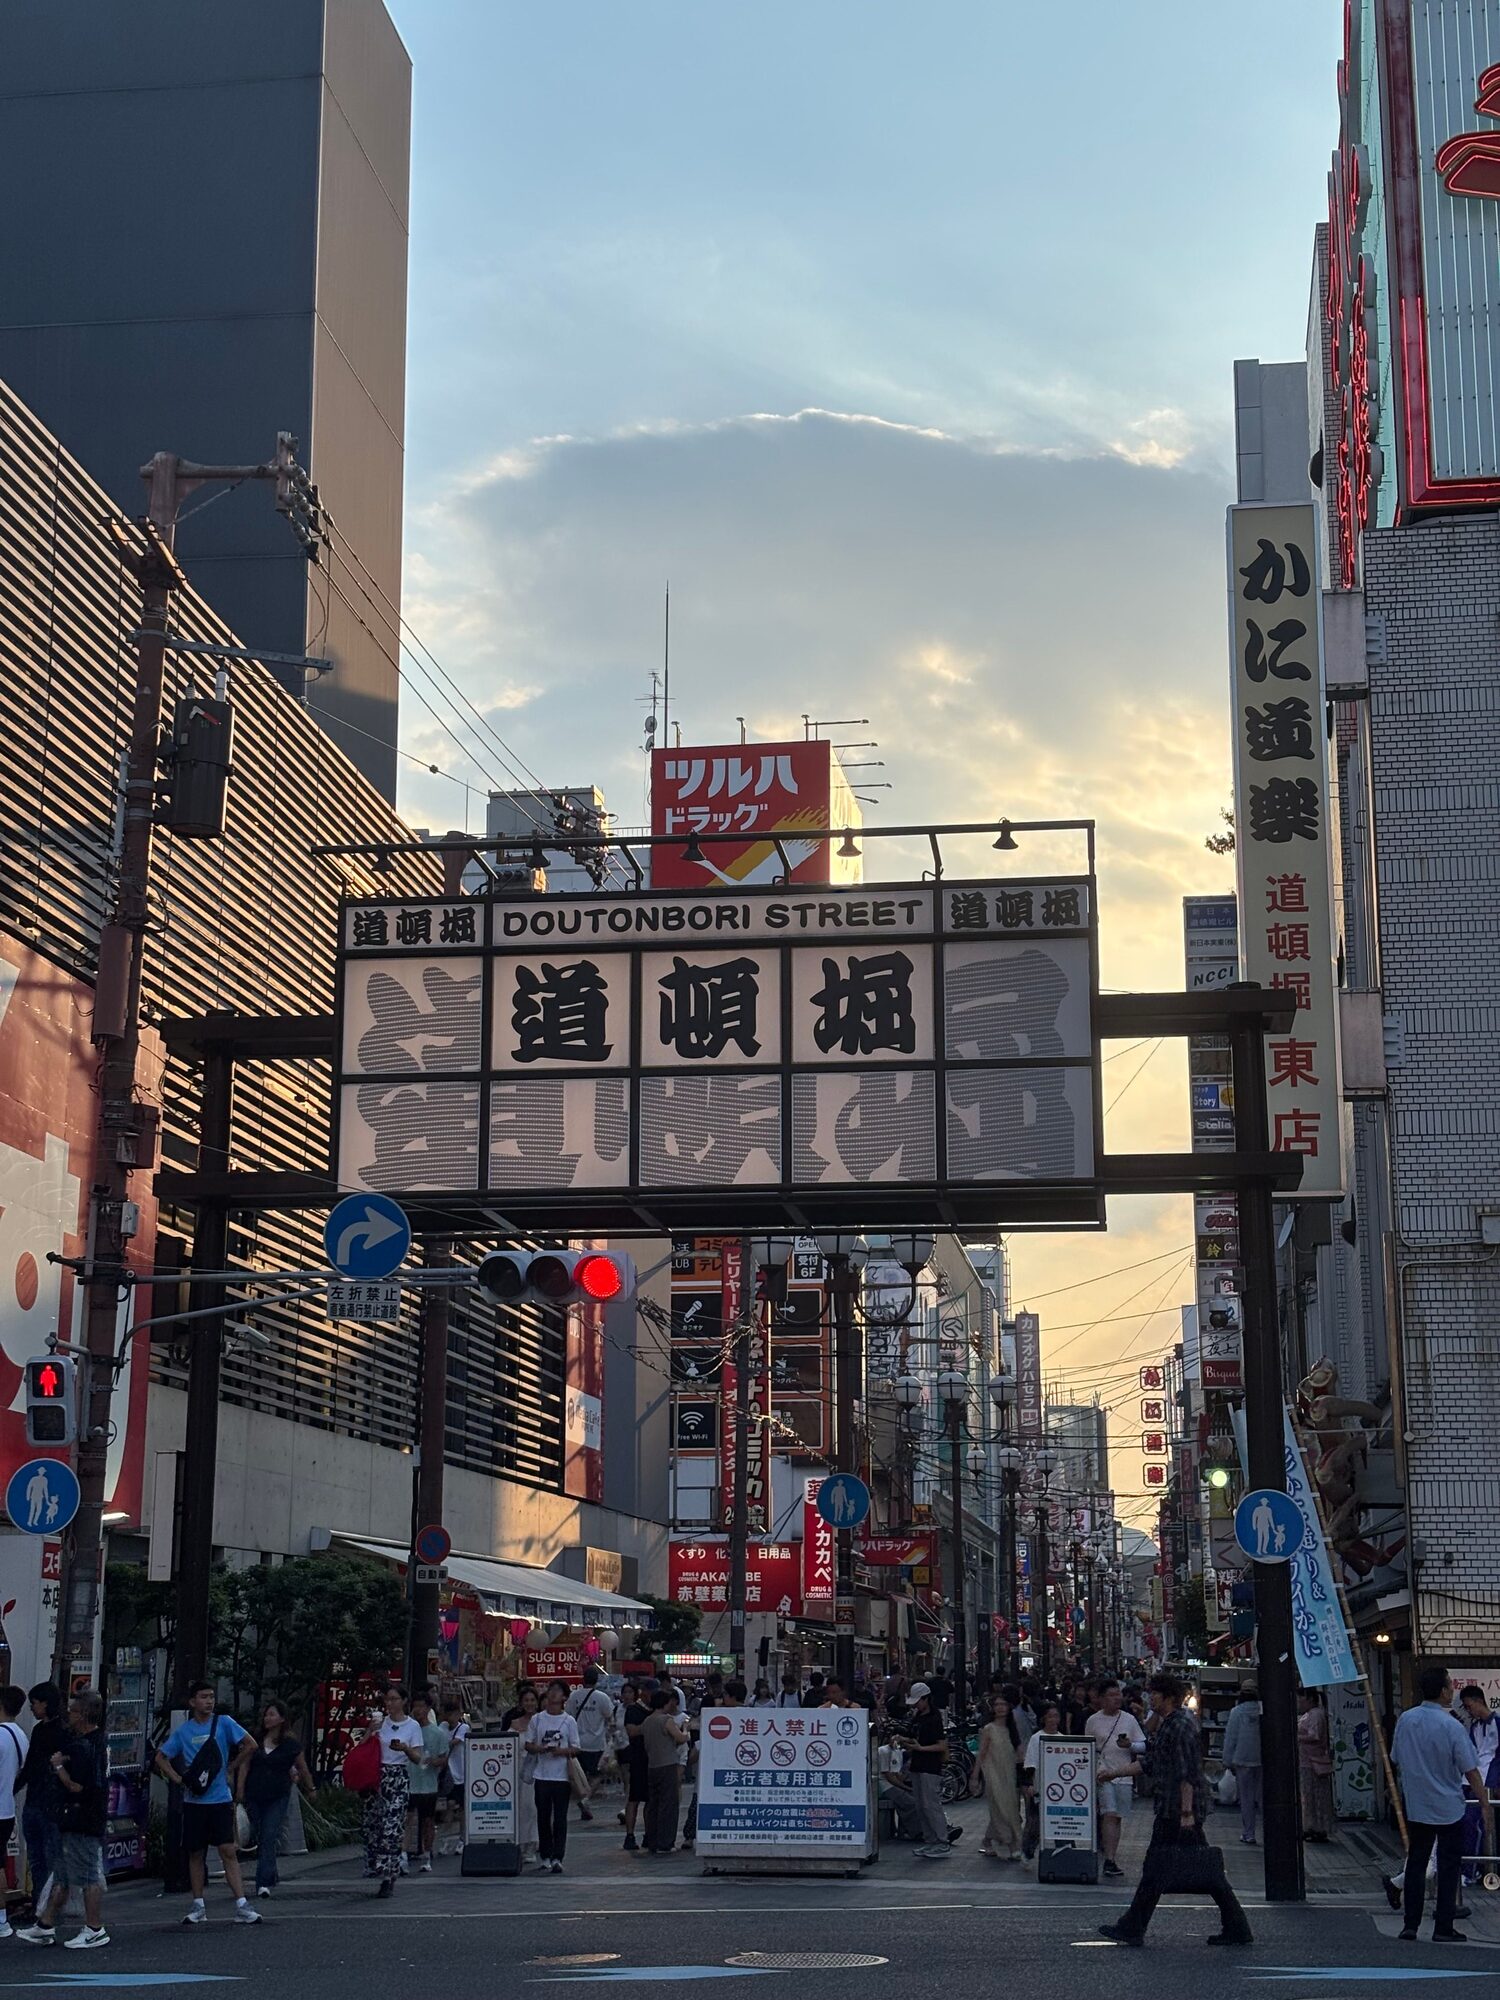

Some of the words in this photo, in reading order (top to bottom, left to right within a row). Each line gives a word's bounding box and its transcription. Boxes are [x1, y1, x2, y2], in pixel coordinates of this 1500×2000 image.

[1239, 538, 1320, 843] かに道楽
[664, 754, 799, 799] ツルハ
[665, 802, 768, 834] ドラッグ
[951, 887, 1081, 929] 道頓堀
[353, 907, 477, 946] 道頓堀
[503, 904, 748, 937] DOUTONBORI
[766, 900, 923, 929] STREET
[1194, 966, 1234, 986] NCCI
[511, 950, 917, 1063] 道頓堀
[1266, 873, 1321, 1158] 道頓堀東店
[1194, 1096, 1216, 1107] Story
[1197, 1120, 1232, 1129] Stella
[798, 1255, 819, 1266] 受付
[801, 1267, 816, 1277] 6F
[331, 1286, 398, 1301] 左折禁止
[677, 1548, 706, 1559] くすり
[758, 1548, 791, 1559] 日用品
[417, 1569, 447, 1579] 自動車
[678, 1586, 761, 1602] 赤壁薬店
[529, 1652, 555, 1663] SUGI
[558, 1652, 580, 1662] DRU
[739, 1718, 828, 1736] 進入禁止
[724, 1771, 842, 1786] 歩行者専用道路
